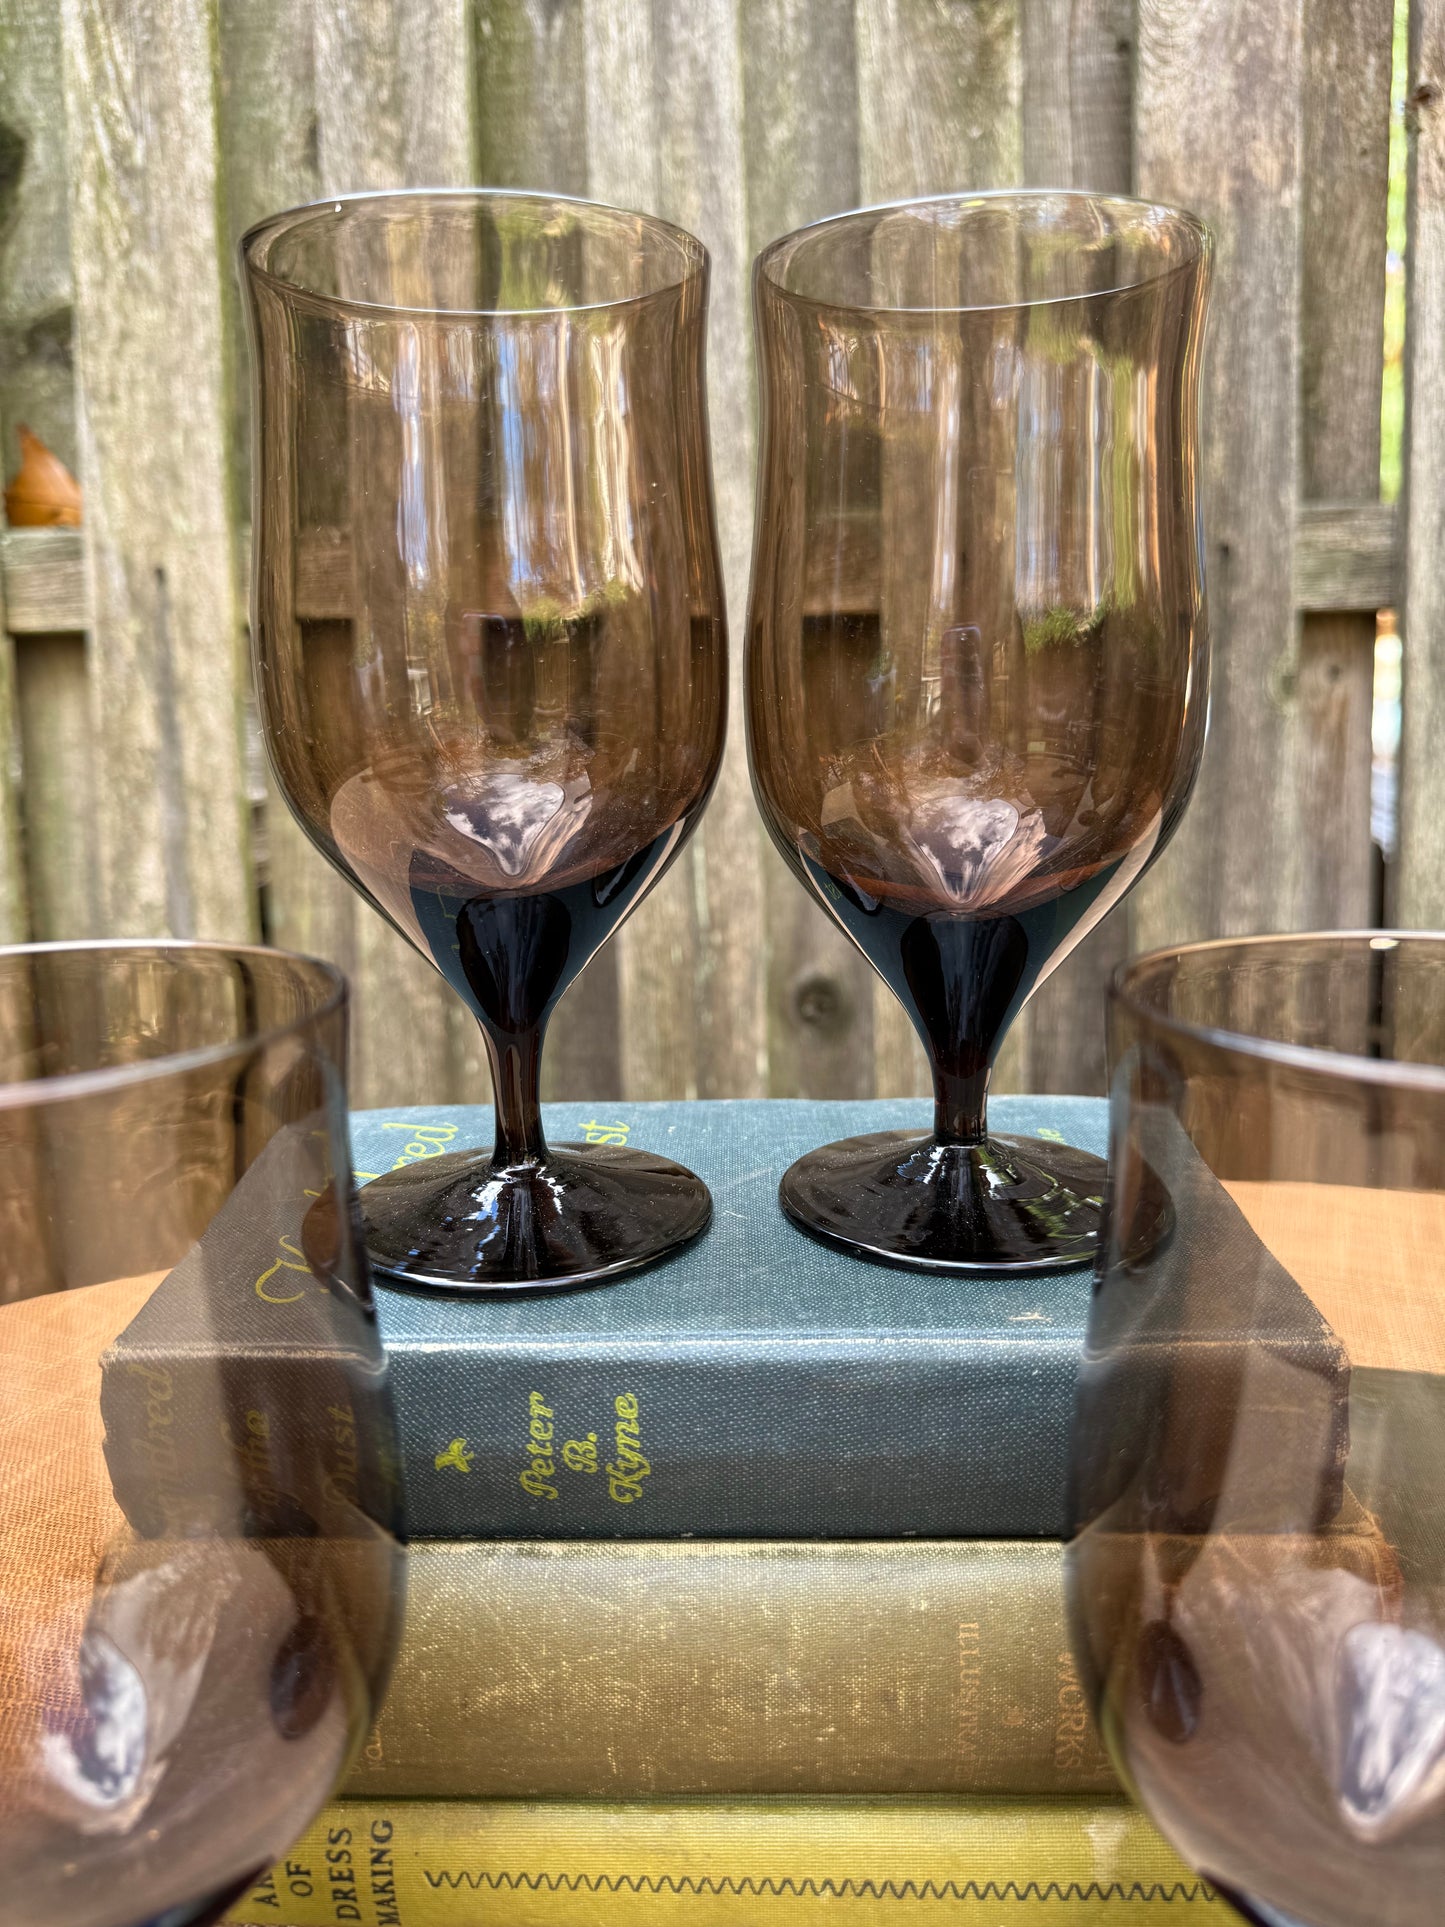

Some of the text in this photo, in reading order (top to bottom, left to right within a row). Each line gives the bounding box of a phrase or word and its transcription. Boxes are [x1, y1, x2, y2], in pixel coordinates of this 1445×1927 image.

[320, 1403, 357, 1504] Dust
[519, 1391, 559, 1500] Peter
[562, 1431, 599, 1474] B.
[605, 1392, 652, 1503] Kyne
[285, 1861, 314, 1897] OF
[325, 1827, 362, 1921] DRESS
[370, 1820, 401, 1926] MAKING
